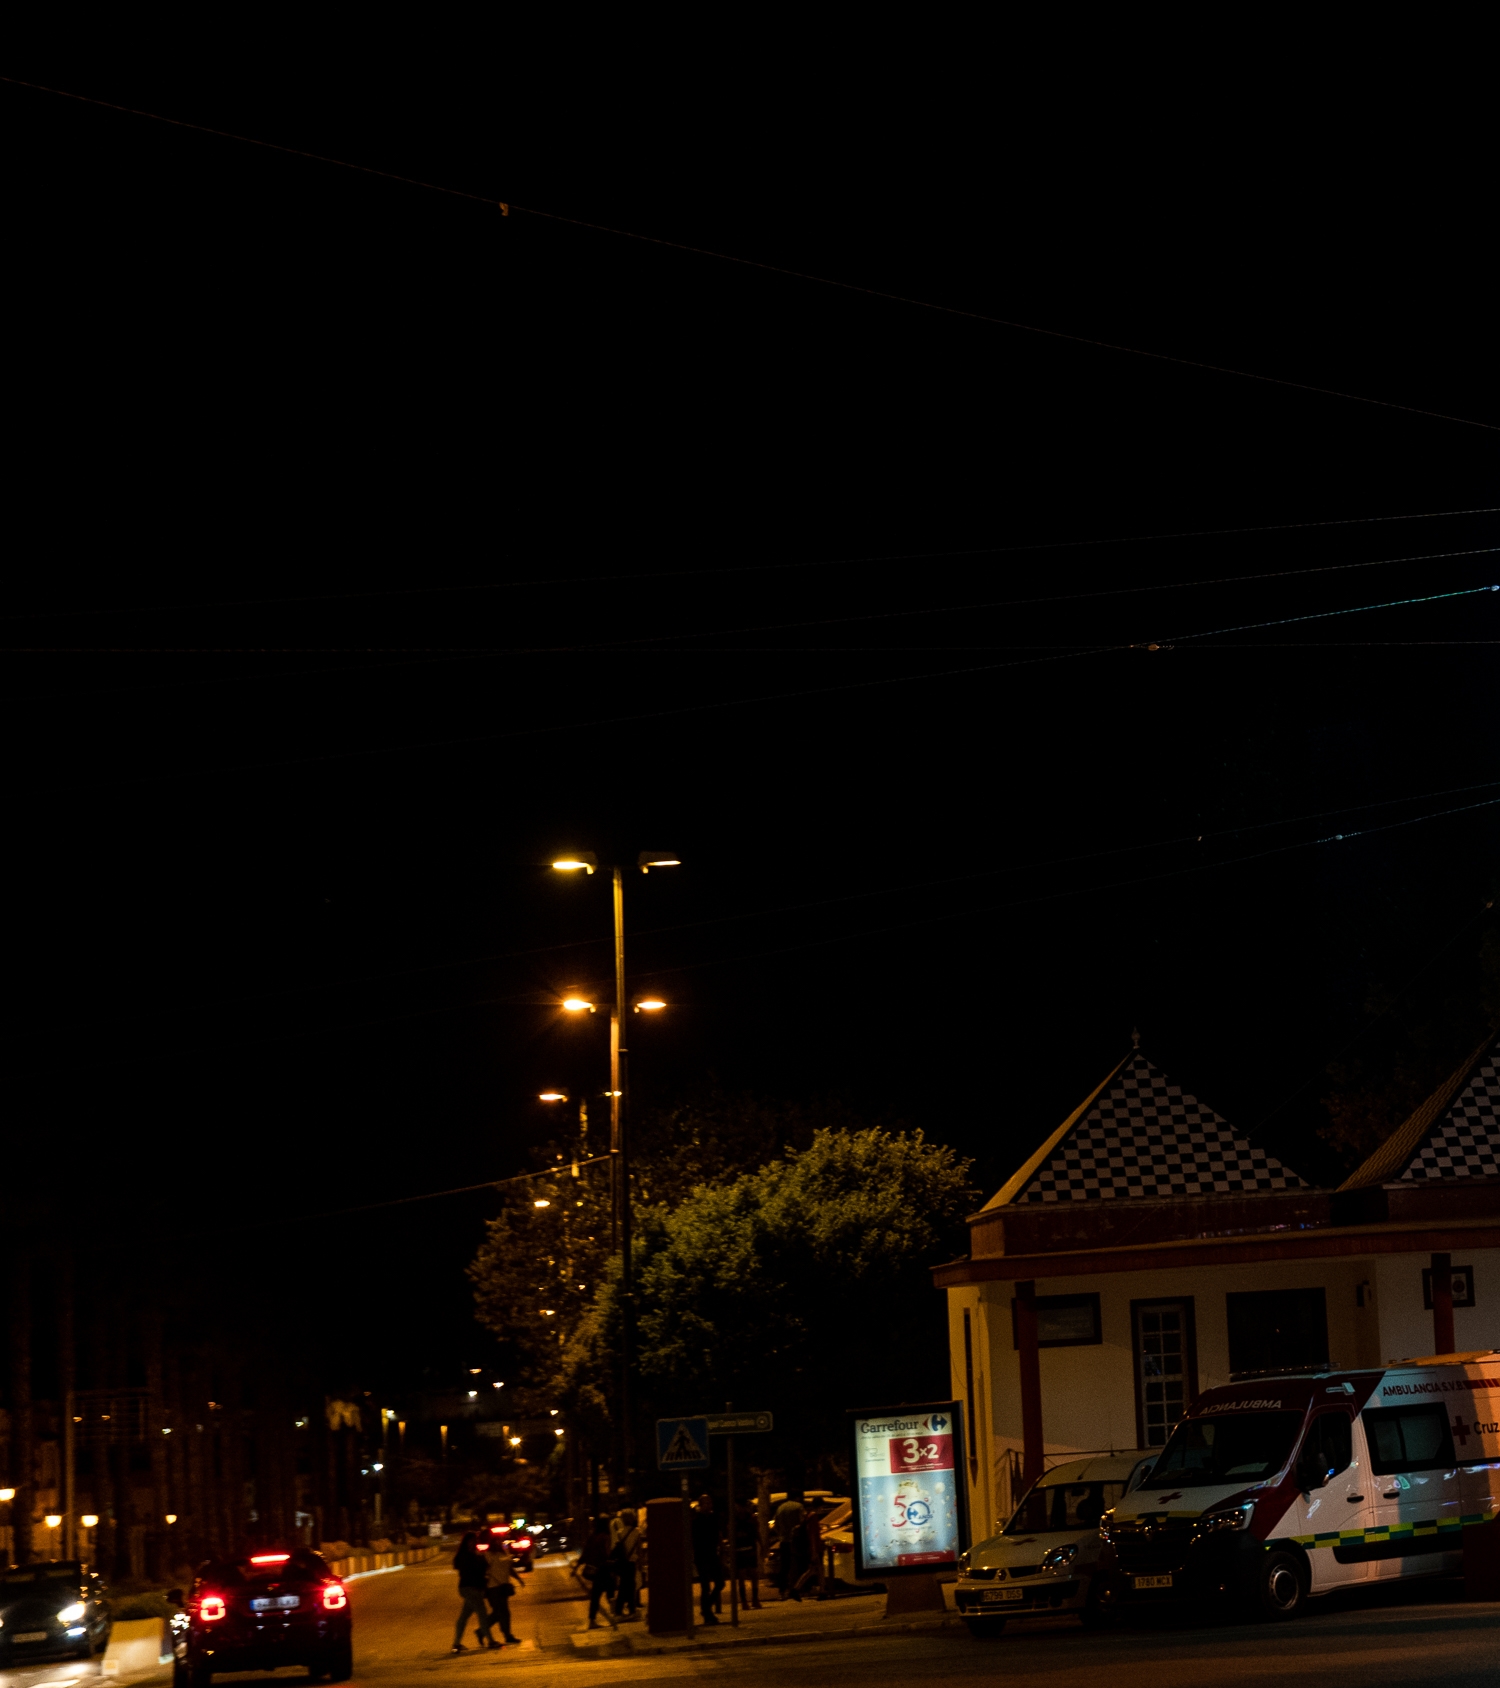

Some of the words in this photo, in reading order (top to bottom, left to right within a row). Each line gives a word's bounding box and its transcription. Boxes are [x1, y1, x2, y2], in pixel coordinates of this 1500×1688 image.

[1383, 1382, 1443, 1396] AMBULANCIA
[1441, 1380, 1466, 1391] S.V.B.
[860, 1419, 919, 1434] Carrefour
[1473, 1421, 1500, 1434] Cruz
